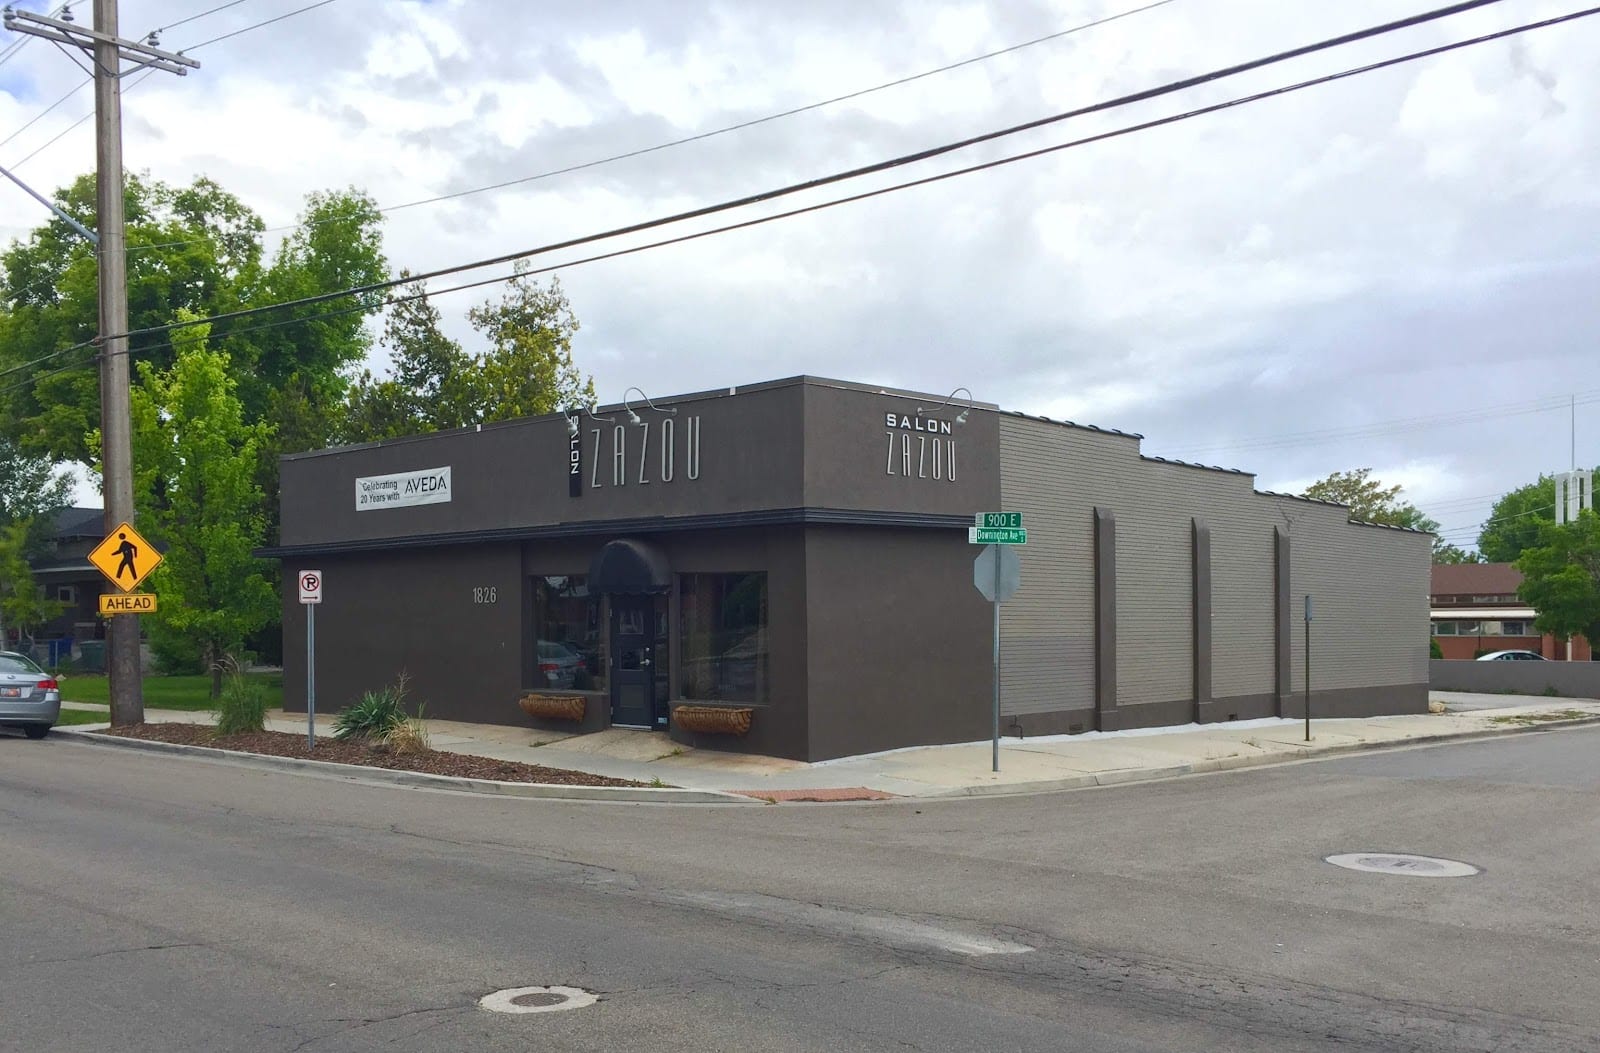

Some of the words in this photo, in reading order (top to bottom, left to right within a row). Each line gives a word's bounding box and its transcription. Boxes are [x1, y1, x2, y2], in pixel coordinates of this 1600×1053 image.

[886, 413, 951, 434] SALON
[591, 416, 700, 488] ZAZOU
[886, 431, 956, 482] ZAZOU
[362, 480, 398, 491] Celebrating
[404, 475, 447, 495] AVEDA
[360, 495, 368, 504] 20
[369, 494, 386, 503] Years
[387, 492, 400, 501] with
[988, 514, 1007, 527] 900
[1010, 514, 1017, 527] E
[977, 529, 1009, 543] Downington
[1009, 530, 1018, 541] Ave
[472, 586, 497, 603] 1826
[106, 597, 151, 610] AHEAD
